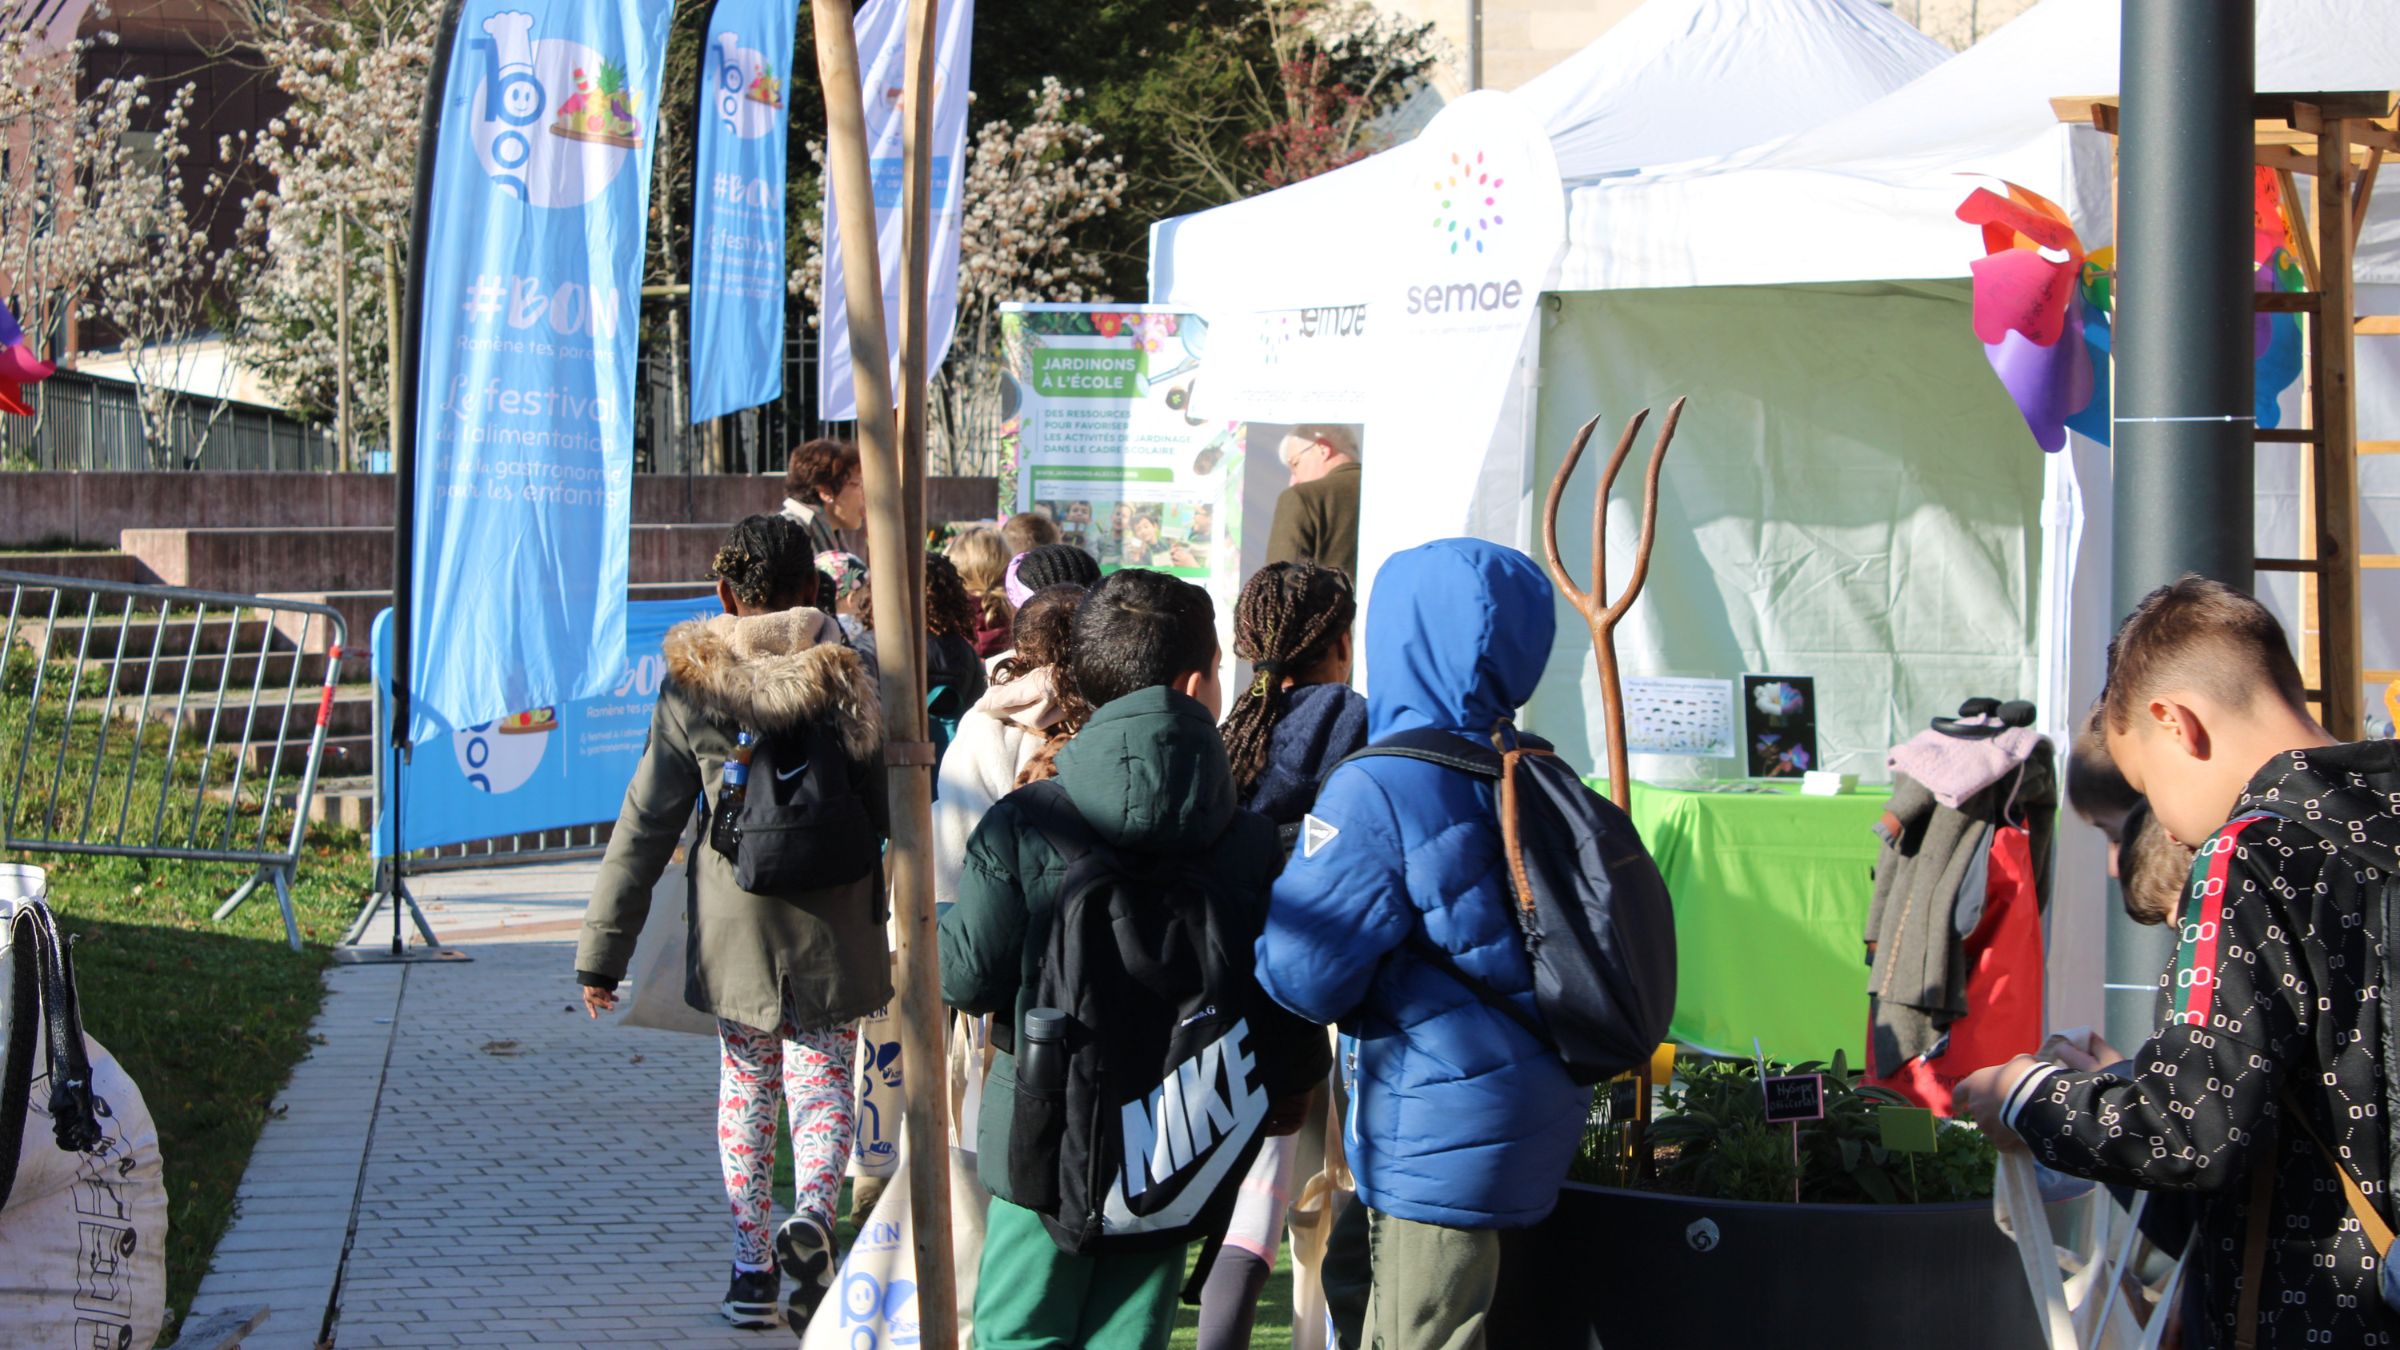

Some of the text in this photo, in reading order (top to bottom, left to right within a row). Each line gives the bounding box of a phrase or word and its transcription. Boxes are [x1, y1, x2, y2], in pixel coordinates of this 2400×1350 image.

[1407, 279, 1523, 314] semae
[463, 274, 619, 340] #BON
[456, 335, 524, 353] Ramène
[528, 341, 555, 356] tes
[1042, 358, 1136, 371] JARDINONS
[1042, 373, 1124, 389] À L'ÉCOLE
[483, 378, 618, 423] festival
[1044, 409, 1131, 419] DES RESSOURCES
[1044, 421, 1129, 431] POUR FAVORISER
[1044, 433, 1061, 442] LES
[1065, 432, 1115, 442] ACTIVITÉS
[1135, 434, 1192, 443] JARDINAGE
[1044, 445, 1175, 455] DANS LE CADRE SCOLAIRE
[522, 481, 618, 508] enfants
[1121, 1017, 1266, 1198] NIKE
